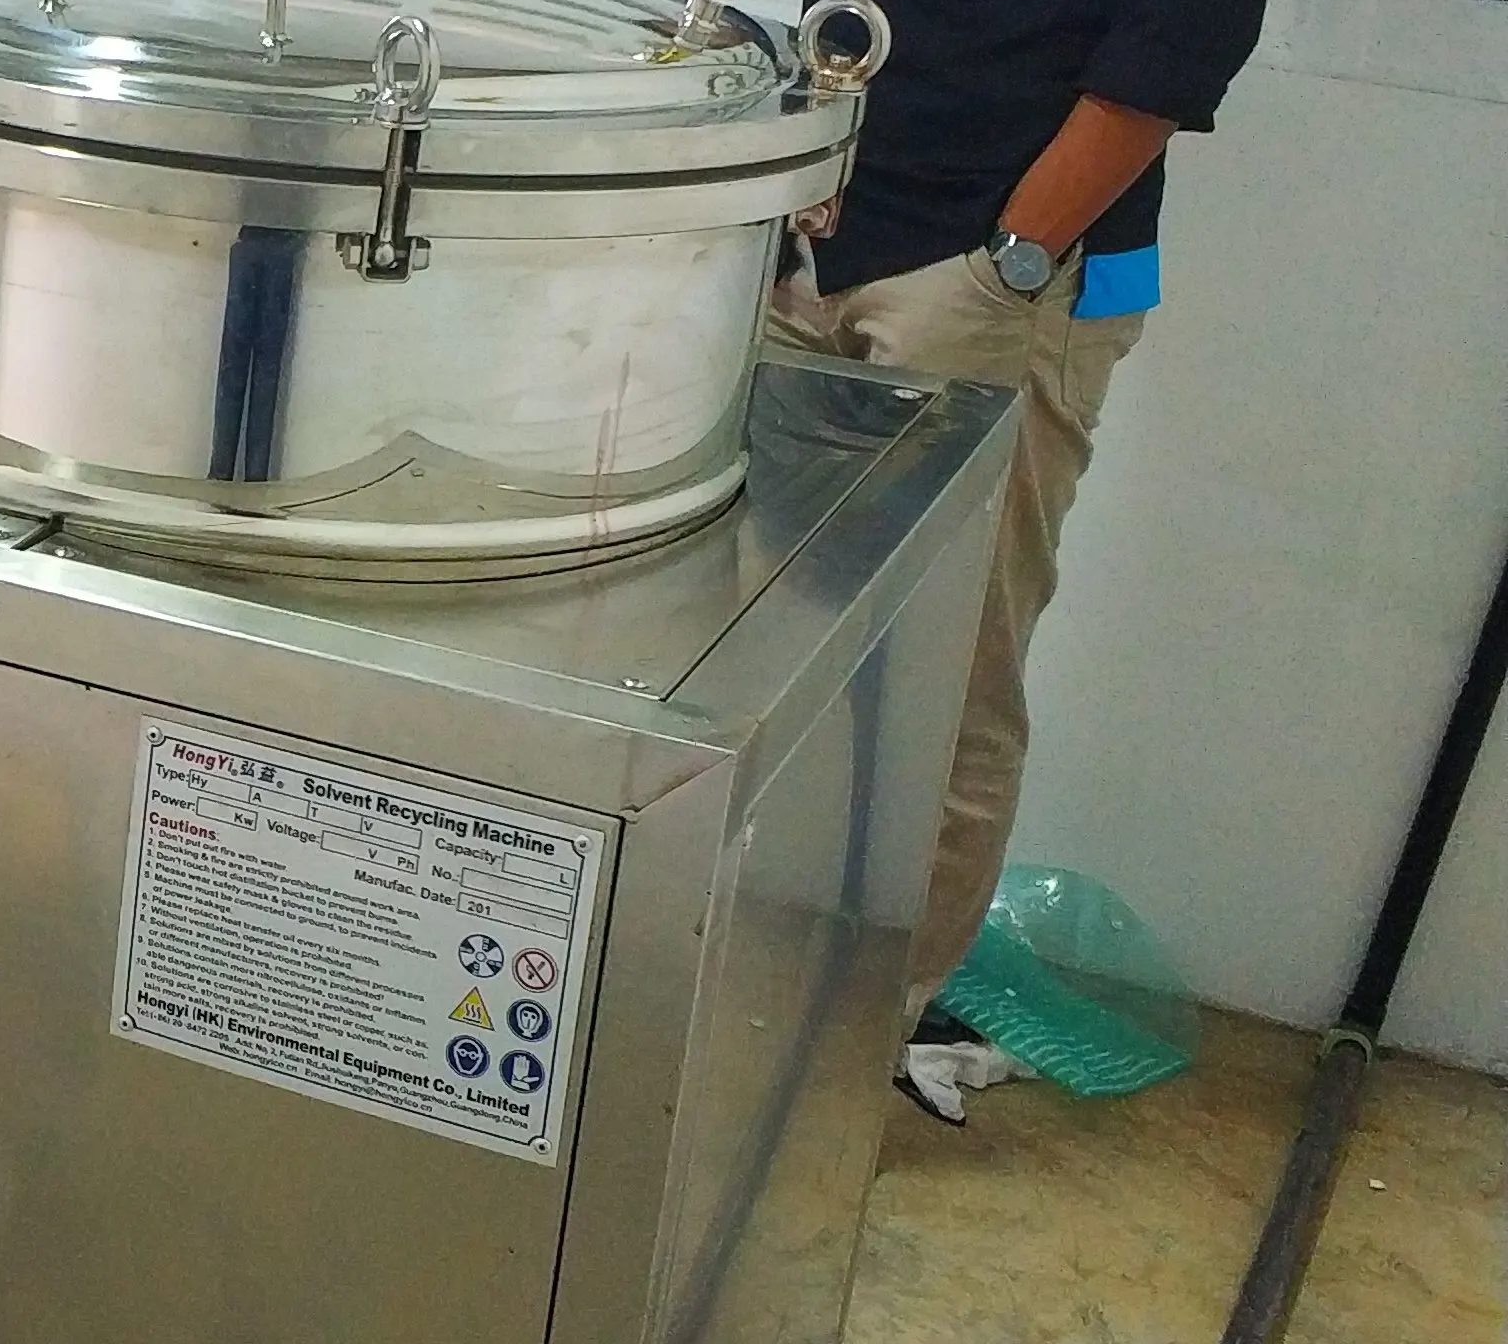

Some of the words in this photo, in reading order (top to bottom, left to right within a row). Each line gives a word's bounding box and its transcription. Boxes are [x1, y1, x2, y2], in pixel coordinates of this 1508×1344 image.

[151, 789, 196, 812] Power:
[232, 812, 254, 830] Kw
[266, 818, 321, 844] Voltage:
[366, 847, 378, 864] V
[155, 762, 190, 783] Type:
[252, 792, 262, 803] A
[311, 806, 319, 818] T
[363, 820, 374, 832] V
[559, 872, 569, 885] L
[184, 838, 201, 848] put
[202, 843, 219, 853] out
[220, 846, 236, 858] fire
[237, 853, 258, 864] with
[302, 777, 373, 811] Solvent
[376, 796, 469, 838] Recycling
[472, 820, 555, 856] Machine
[152, 885, 163, 893] of
[163, 888, 194, 901] power
[154, 872, 193, 891] Machine
[194, 886, 219, 899] must
[220, 891, 234, 902] be
[233, 897, 285, 917] connected
[286, 911, 297, 920] to
[337, 925, 349, 935] to
[350, 930, 389, 946] prevent
[155, 862, 187, 878] Please
[188, 872, 211, 885] wear
[212, 880, 242, 895] safety
[243, 888, 269, 901] mask
[271, 895, 279, 904] &
[281, 899, 313, 914] gloves
[315, 907, 326, 917] to
[327, 912, 355, 925] clean
[356, 919, 372, 930] the
[157, 840, 199, 861] Smoking
[200, 852, 209, 861] &
[210, 855, 227, 866] fire
[227, 861, 244, 871] are
[245, 866, 279, 882] strictly
[279, 876, 332, 896] prohibited
[332, 890, 369, 906] around
[369, 900, 395, 913] work
[182, 859, 210, 873] touch
[211, 867, 228, 878] hot
[281, 886, 315, 903] bucket
[316, 896, 327, 906] to
[328, 901, 367, 918] prevent
[148, 929, 159, 937] or
[274, 965, 318, 984] recovery
[319, 978, 329, 986] is
[149, 916, 193, 936] Solutions
[196, 931, 211, 941] are
[243, 943, 255, 956] by
[256, 949, 302, 967] solutions
[303, 961, 327, 975] from
[328, 969, 371, 988] different
[150, 905, 188, 923] Without
[242, 934, 289, 952] operation
[290, 947, 300, 956] is
[151, 894, 183, 911] Please
[184, 905, 220, 921] replace
[220, 915, 242, 928] heat
[243, 921, 281, 938] transfer
[282, 934, 296, 943] oil
[296, 938, 324, 952] every
[325, 946, 340, 955] six
[143, 981, 161, 993] tain
[162, 988, 187, 1001] more
[214, 1004, 257, 1023] recovery
[257, 1015, 267, 1025] is
[146, 950, 166, 962] able
[167, 956, 218, 977] dangerous
[267, 986, 311, 1005] recovery
[311, 997, 321, 1007] is
[147, 938, 192, 958] Solutions
[193, 953, 229, 969] contain
[229, 964, 255, 976] more
[371, 1005, 383, 1013] or
[150, 960, 195, 981] Solutions
[196, 976, 212, 986] are
[259, 994, 270, 1004] to
[317, 1012, 341, 1024] steel
[342, 1019, 354, 1027] or
[387, 1032, 413, 1045] such
[144, 971, 175, 988] strong
[200, 988, 231, 1005] strong
[311, 1021, 344, 1037] strong
[392, 1044, 404, 1053] or
[137, 989, 190, 1018] Hongyi
[192, 1006, 224, 1030] (HK)
[227, 1017, 340, 1063] Environmental
[343, 1051, 430, 1089] Equipment
[466, 1087, 530, 1117] Limited
